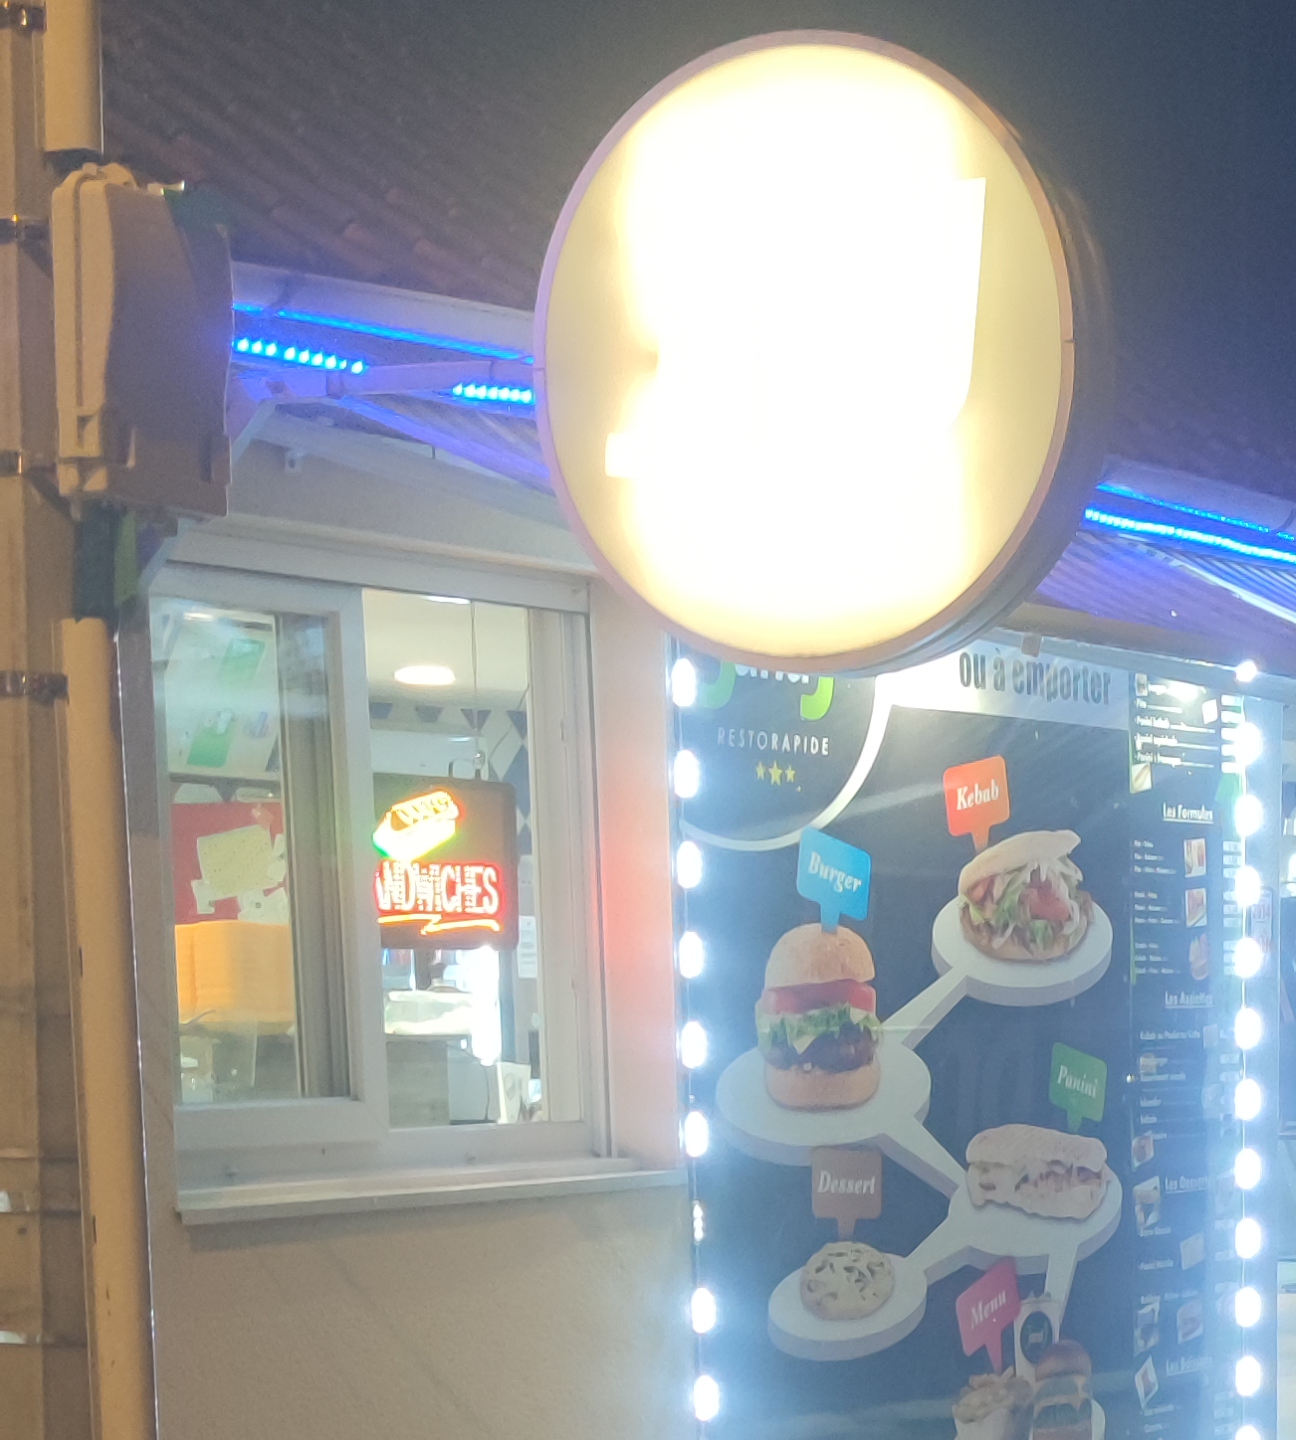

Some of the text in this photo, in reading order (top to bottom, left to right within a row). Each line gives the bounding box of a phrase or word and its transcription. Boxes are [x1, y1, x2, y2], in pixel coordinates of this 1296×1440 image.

[959, 651, 987, 690] ou
[993, 647, 1006, 692] à
[1012, 658, 1112, 706] emporter
[717, 726, 830, 756] RESTORAPIDE
[955, 777, 1000, 811] Kebab
[807, 851, 863, 894] Burger
[1056, 1065, 1099, 1099] Panini
[816, 1169, 876, 1195] Dessert
[970, 1289, 1007, 1331] Menu
